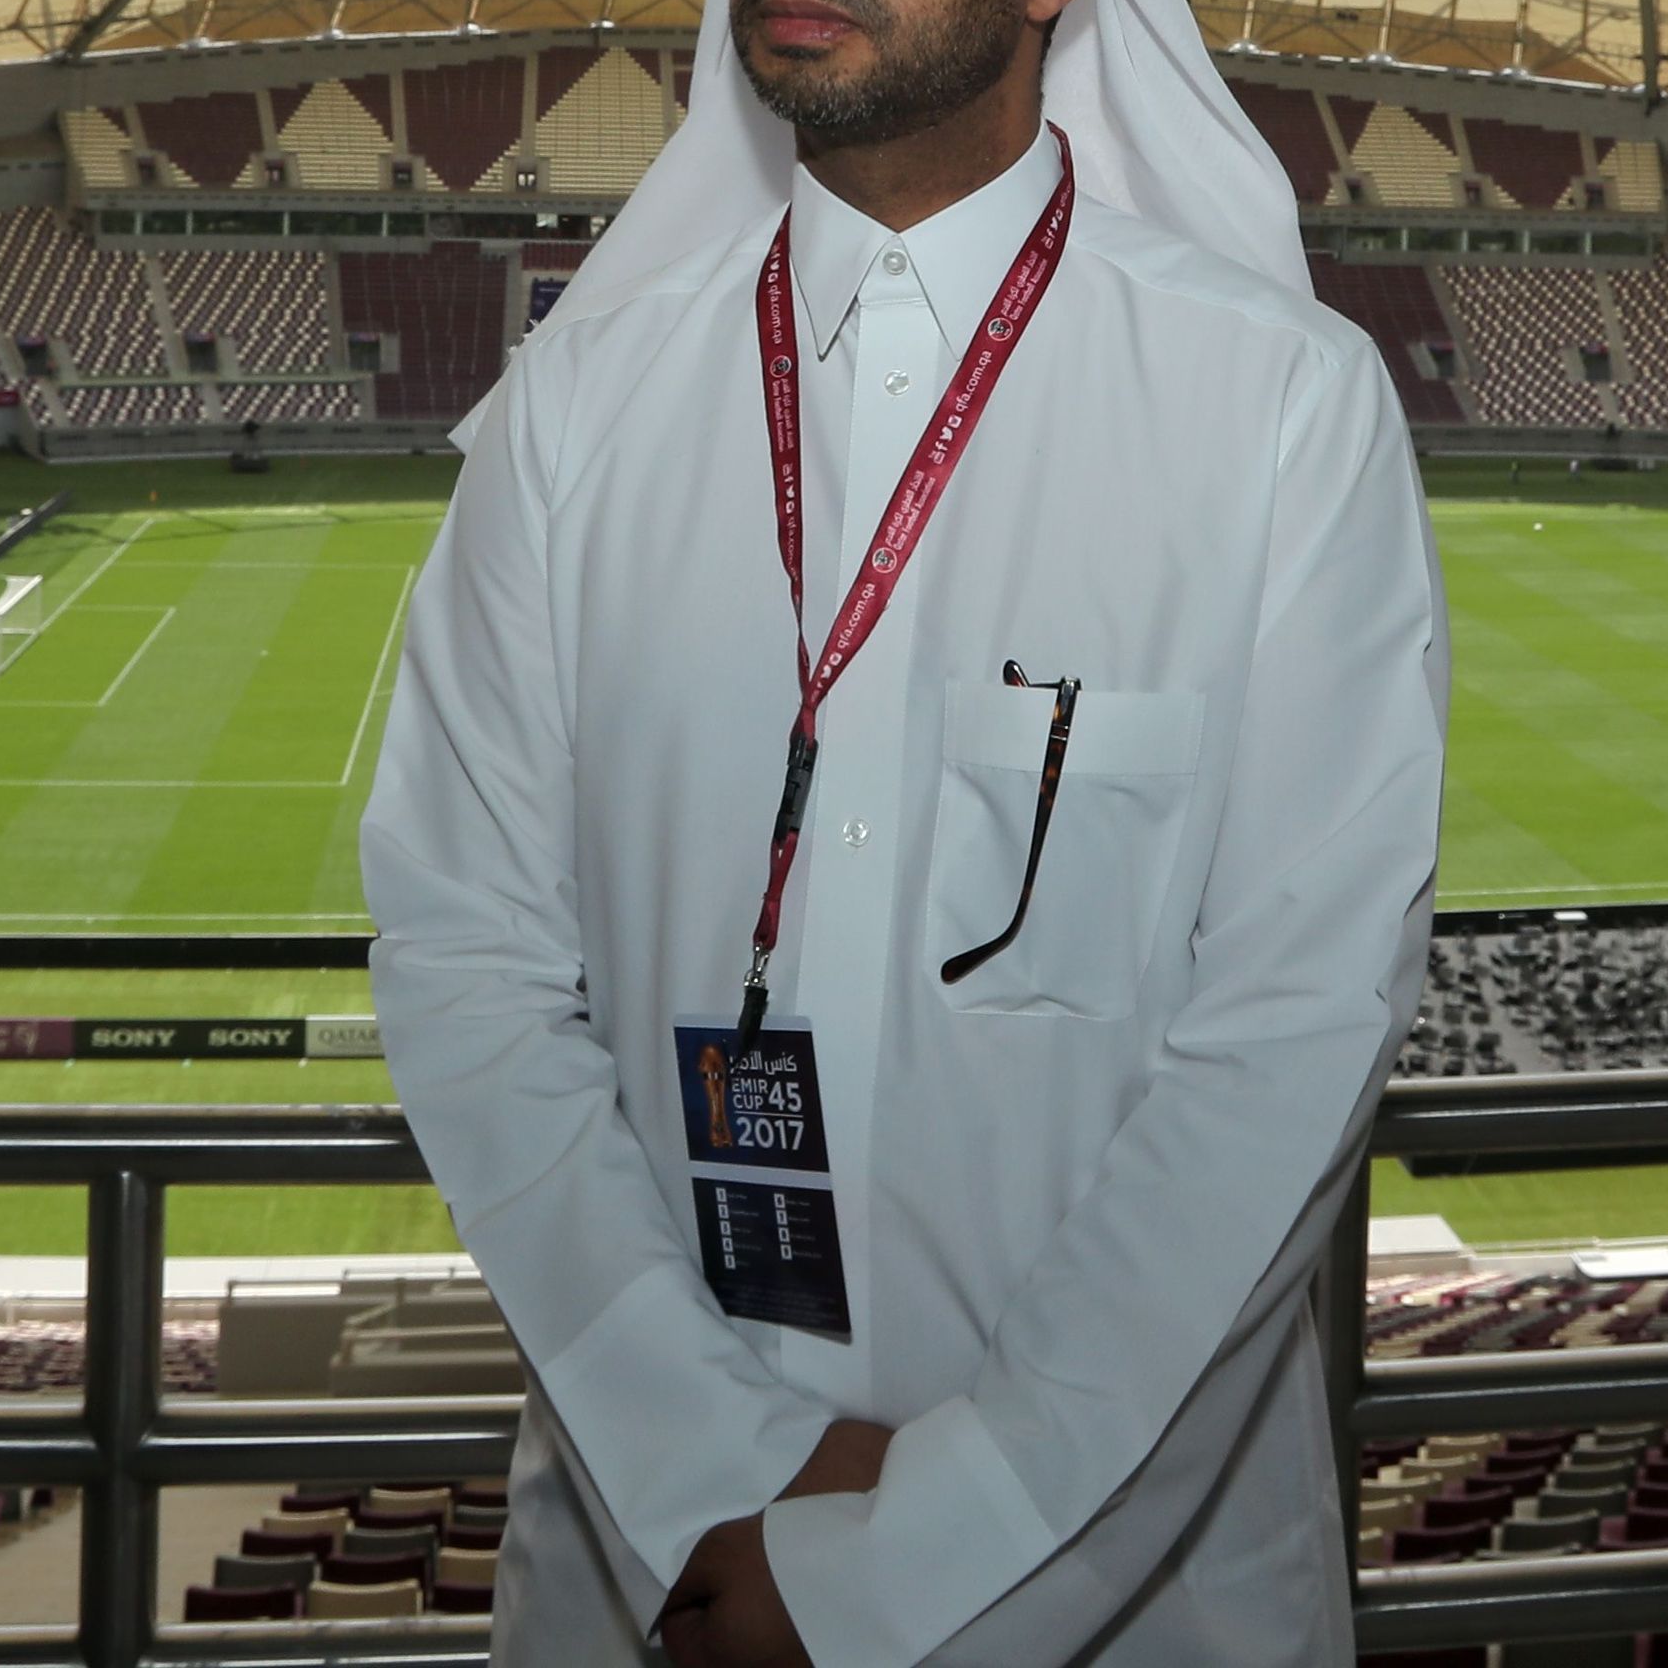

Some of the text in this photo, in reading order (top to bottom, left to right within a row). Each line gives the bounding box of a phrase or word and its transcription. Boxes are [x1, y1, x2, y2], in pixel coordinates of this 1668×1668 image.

[768, 285, 782, 344] qfa.com.qa
[955, 351, 992, 412] qfa.com.qa
[837, 583, 875, 649] qfa.com.qa
[90, 1029, 175, 1048] SONY
[208, 1028, 291, 1047] SONY
[731, 1077, 768, 1094] EMIR
[769, 1081, 803, 1112] 45
[733, 1094, 764, 1110] CUP
[736, 1116, 804, 1150] 2017
